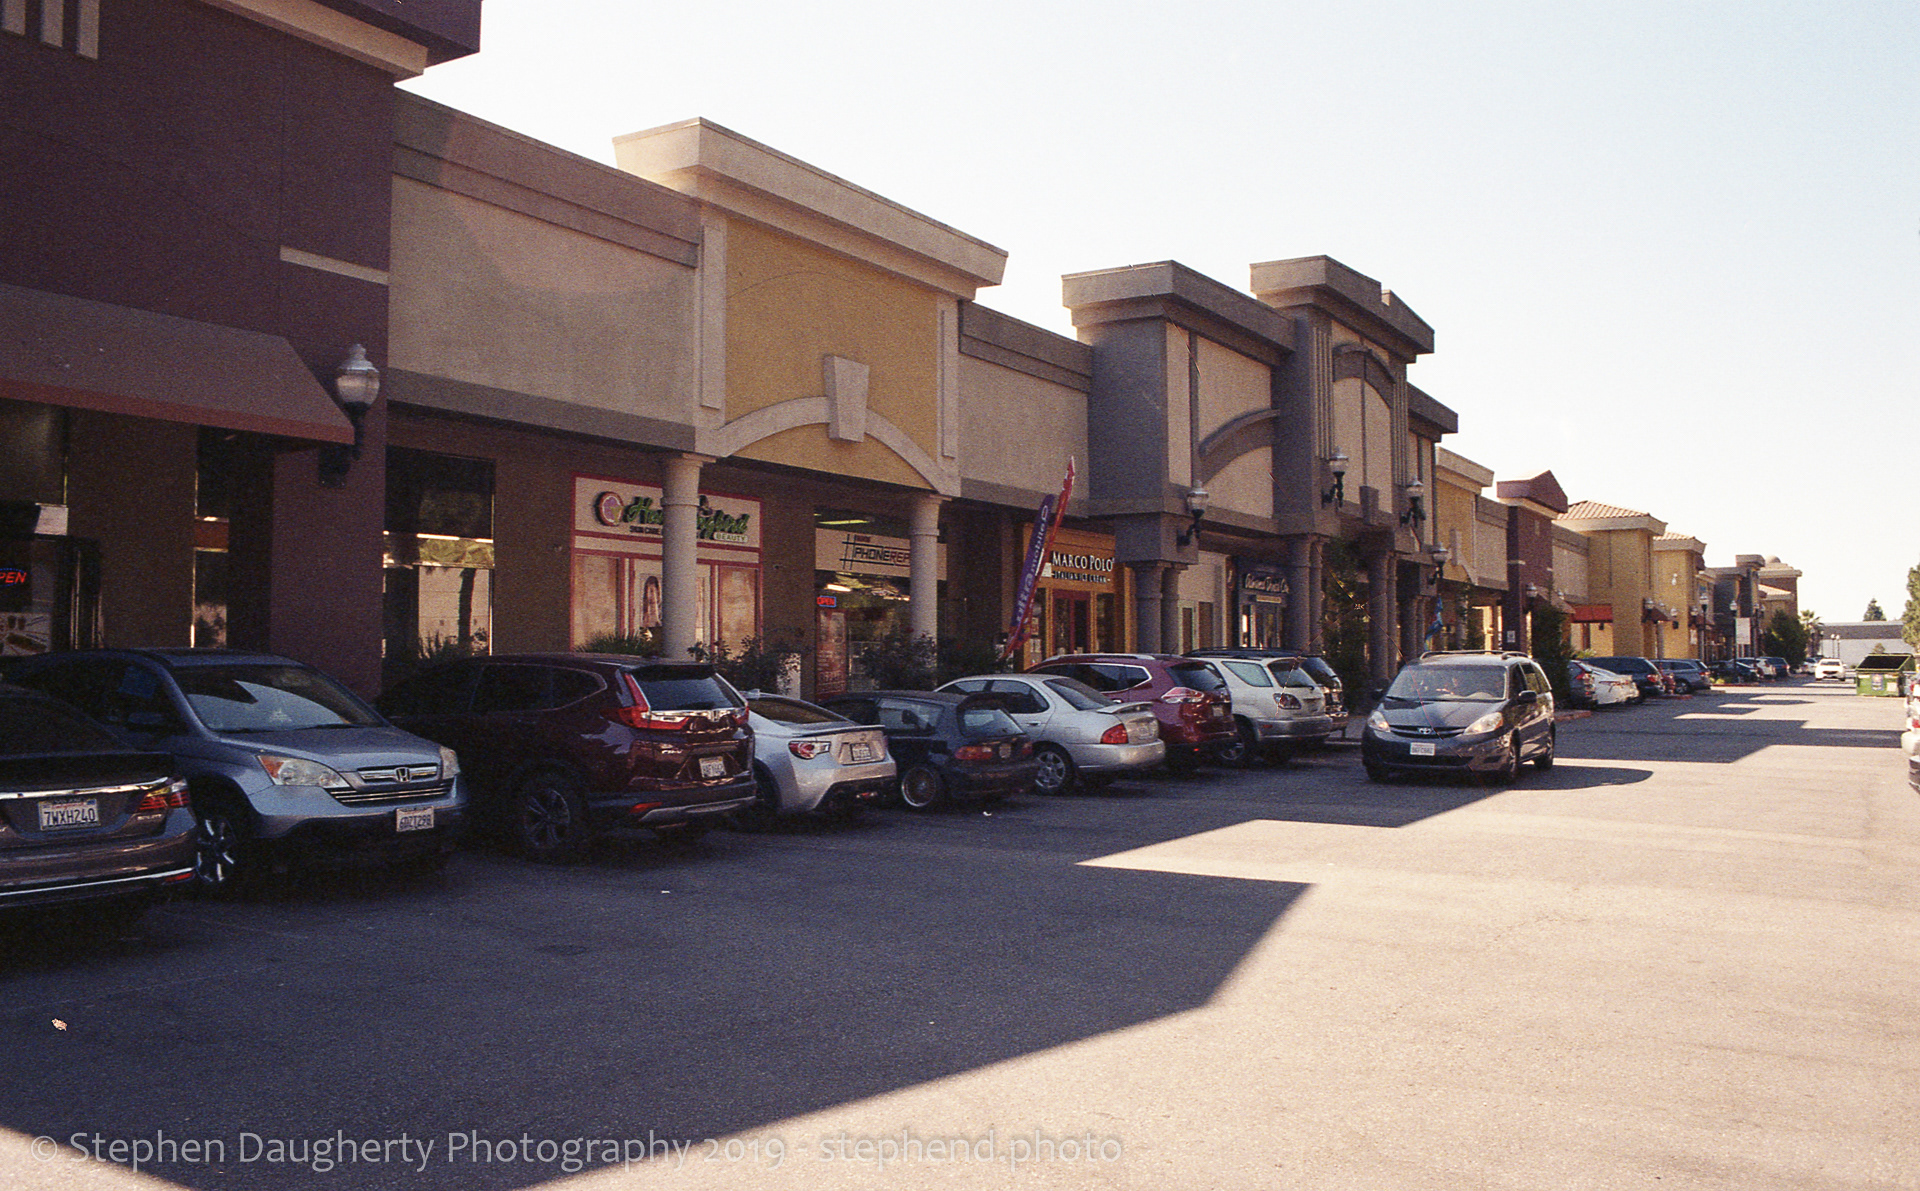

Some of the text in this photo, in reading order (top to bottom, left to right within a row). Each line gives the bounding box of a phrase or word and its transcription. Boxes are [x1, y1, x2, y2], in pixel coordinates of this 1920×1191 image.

[626, 497, 750, 539] Hungbird
[715, 532, 746, 542] BEAUTY
[855, 547, 910, 563] PHONEREP
[1031, 522, 1046, 573] mobile
[1052, 551, 1113, 572] MARCO POLO
[0, 572, 27, 583] PEN
[44, 808, 96, 826] 7WXH240
